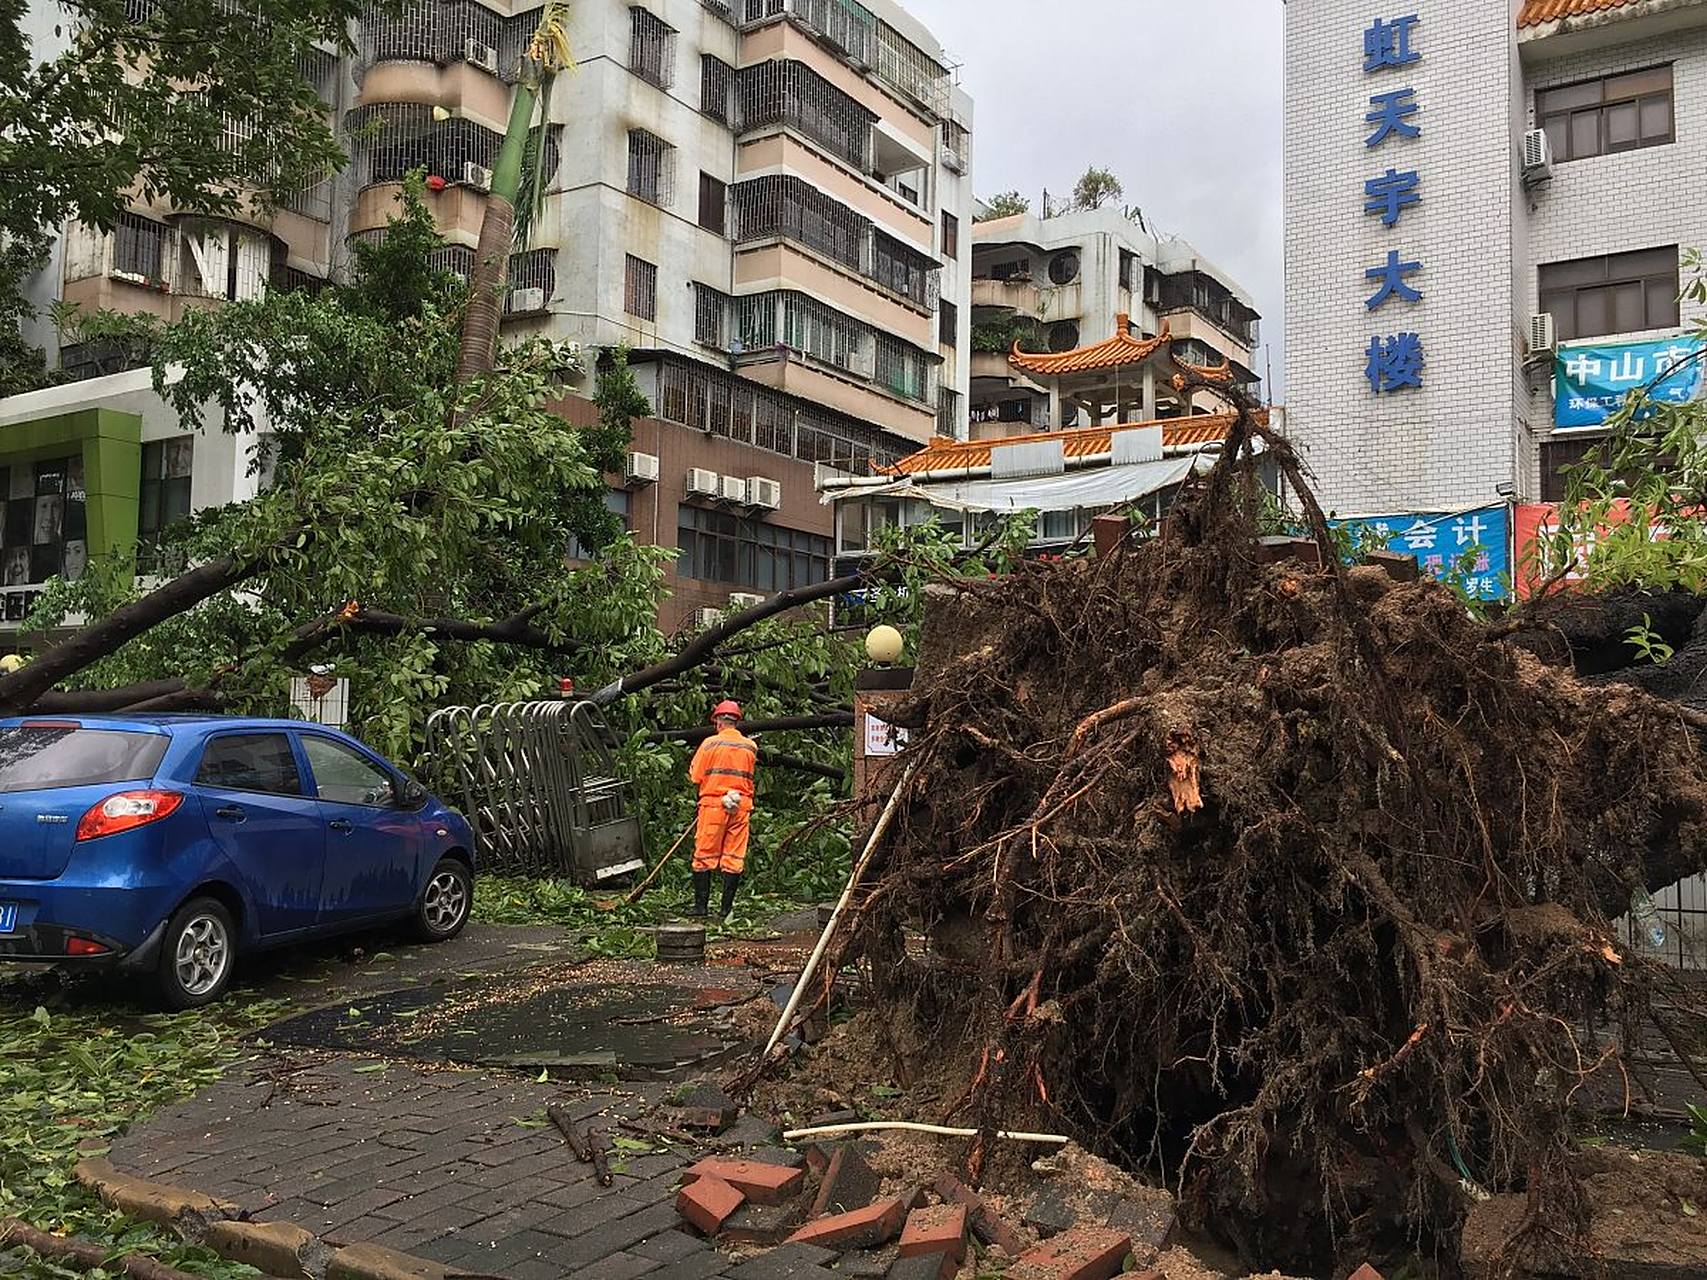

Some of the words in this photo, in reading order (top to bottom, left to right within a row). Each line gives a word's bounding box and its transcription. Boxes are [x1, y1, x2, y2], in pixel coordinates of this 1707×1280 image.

[1363, 14, 1424, 392] 虹天宇大楼
[1566, 344, 1707, 386] 中山市
